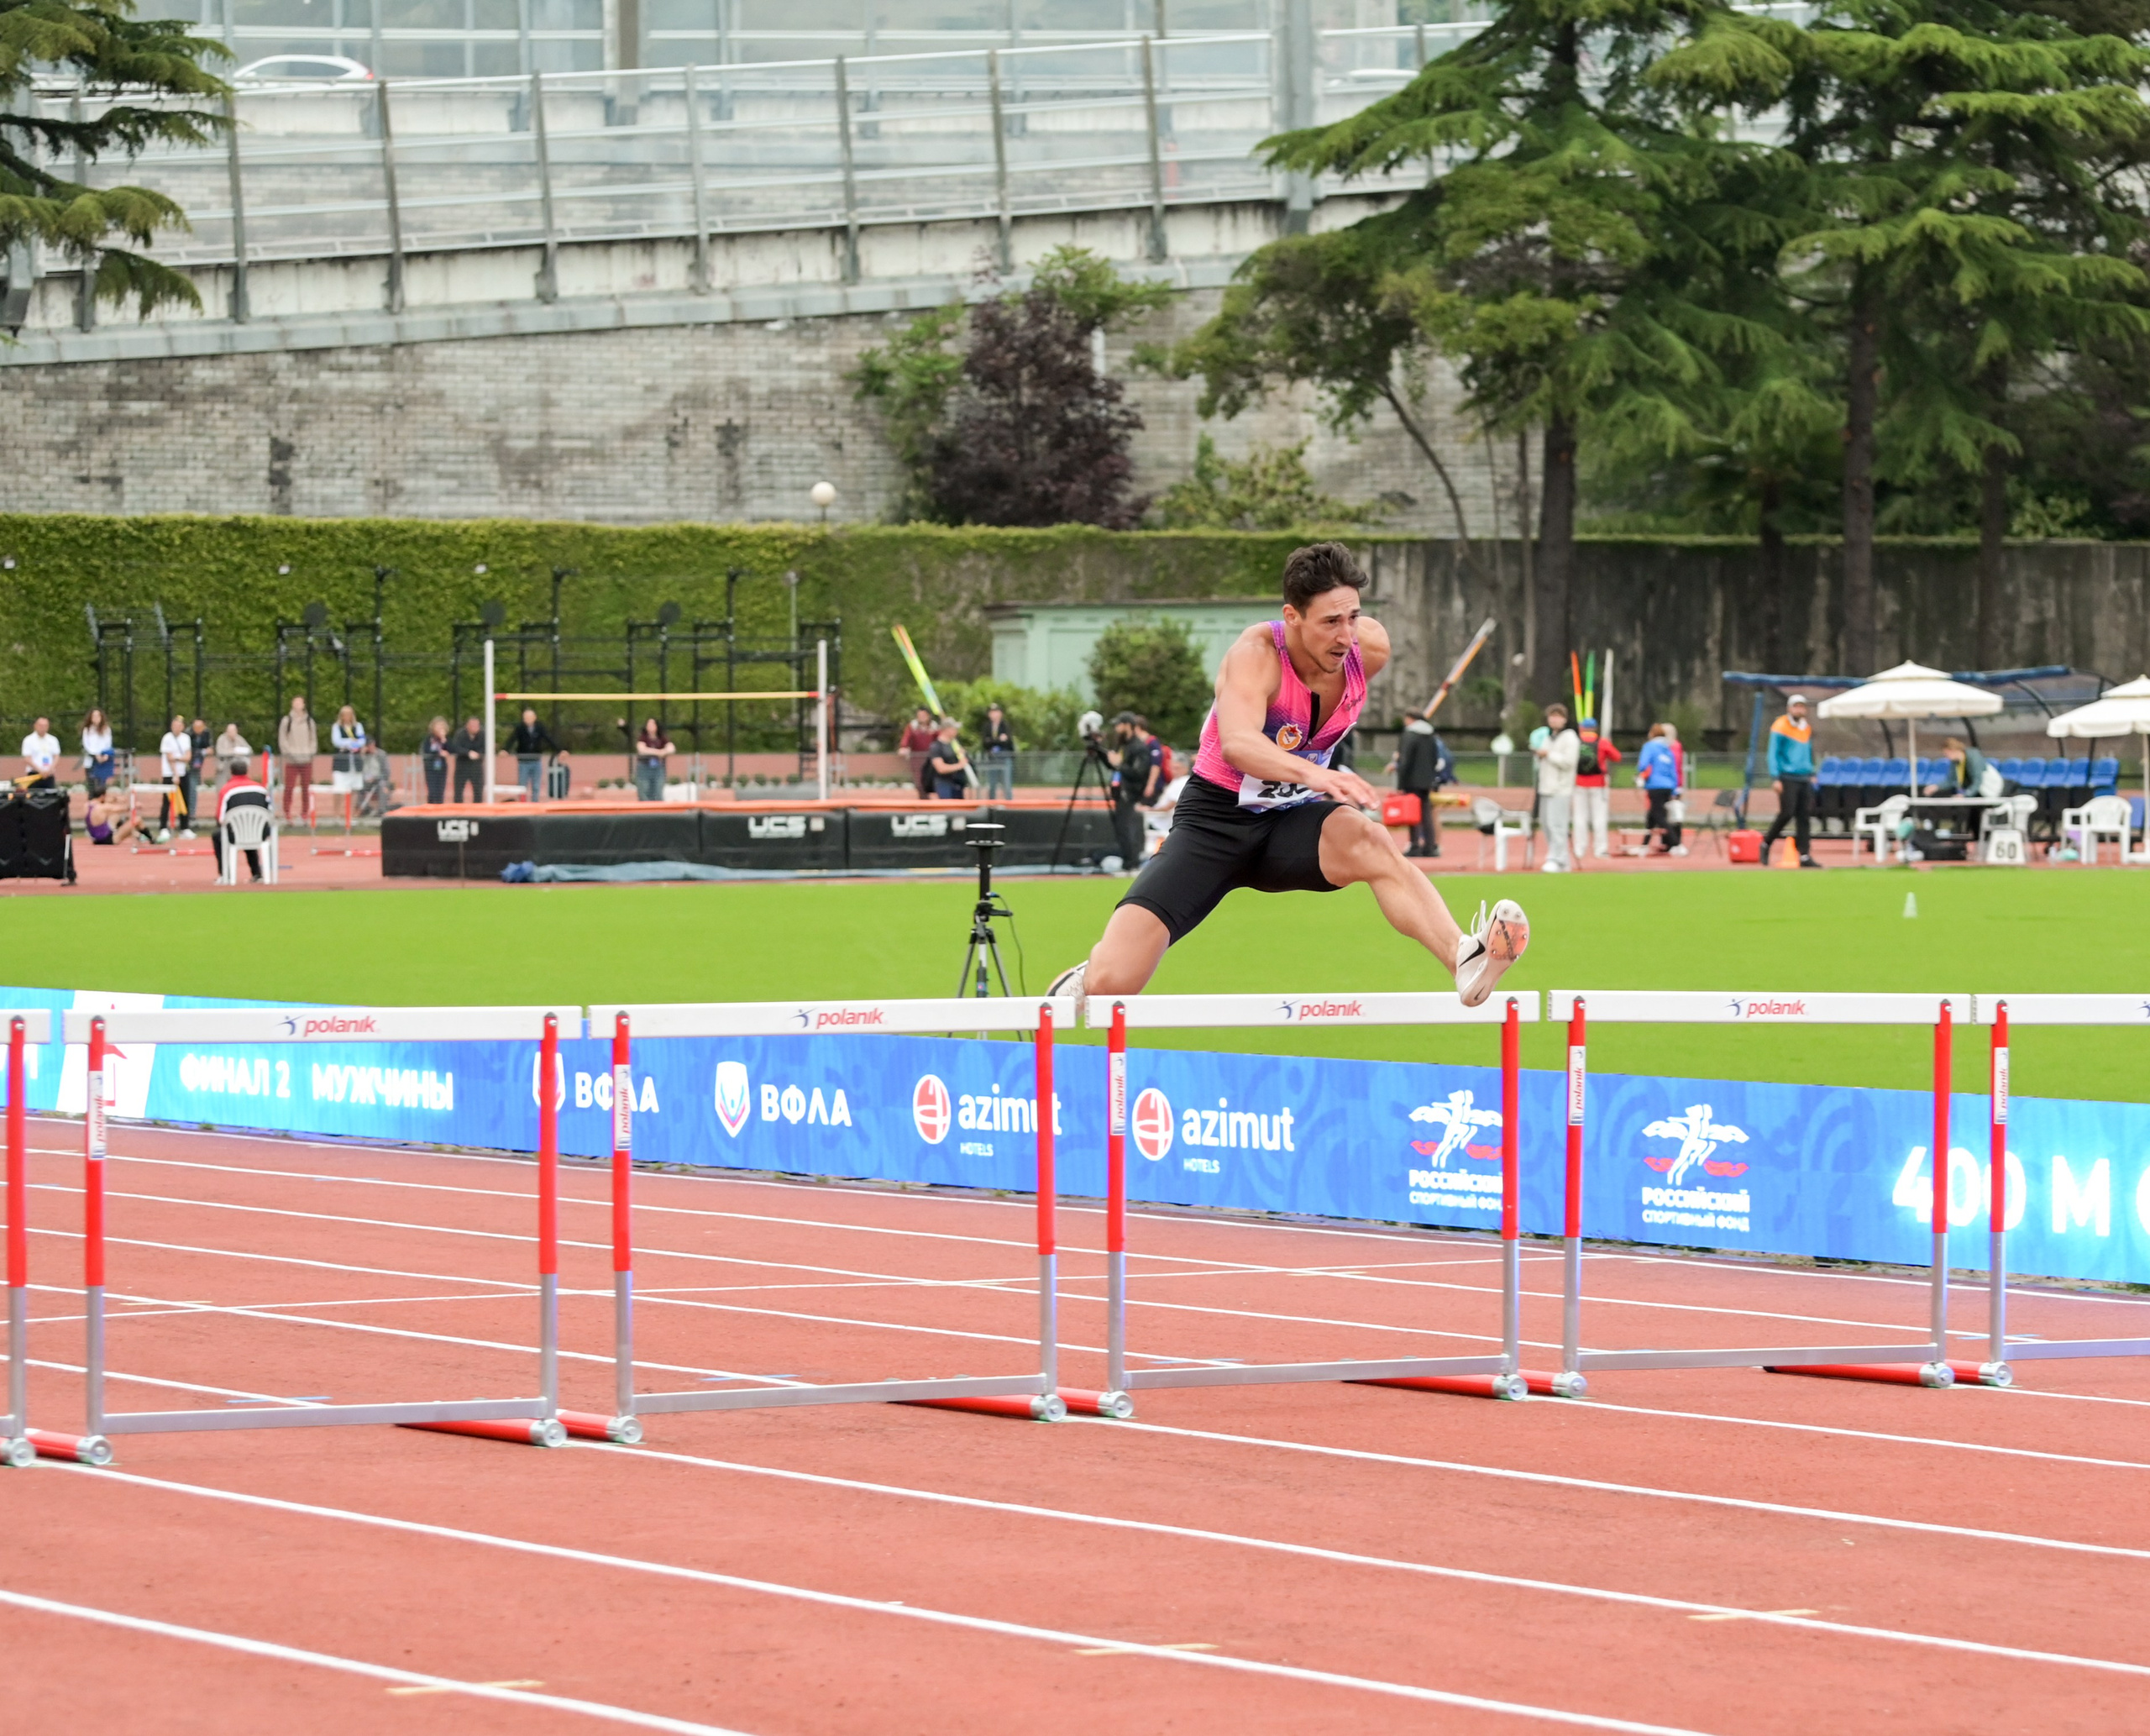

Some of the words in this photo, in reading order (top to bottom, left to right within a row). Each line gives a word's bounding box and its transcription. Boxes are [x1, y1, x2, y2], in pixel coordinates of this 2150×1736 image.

[438, 820, 469, 836] UCS
[748, 816, 806, 831] UCS
[891, 815, 947, 831] UCS
[1995, 841, 2017, 859] 60
[816, 1008, 885, 1030] polanik
[1299, 1000, 1362, 1020] polanik
[1747, 999, 1806, 1018] polanik
[303, 1015, 377, 1037] polanik
[179, 1053, 270, 1096] ФИНАЛ
[275, 1060, 291, 1098] 2
[312, 1062, 454, 1110] МУЖЧИНЫ
[1573, 1067, 1583, 1109] polanik
[761, 1083, 852, 1127] ВФЛА
[1114, 1075, 1125, 1120] polanik
[619, 1087, 630, 1134] polanik
[1182, 1097, 1295, 1151] azimut
[960, 1142, 994, 1156] HOTELS
[1183, 1158, 1220, 1173] HOTELS
[1642, 1186, 1750, 1213] РОССИЙСКИЙ
[1892, 1146, 2027, 1231] 400
[1716, 1215, 1750, 1232] ФОНД
